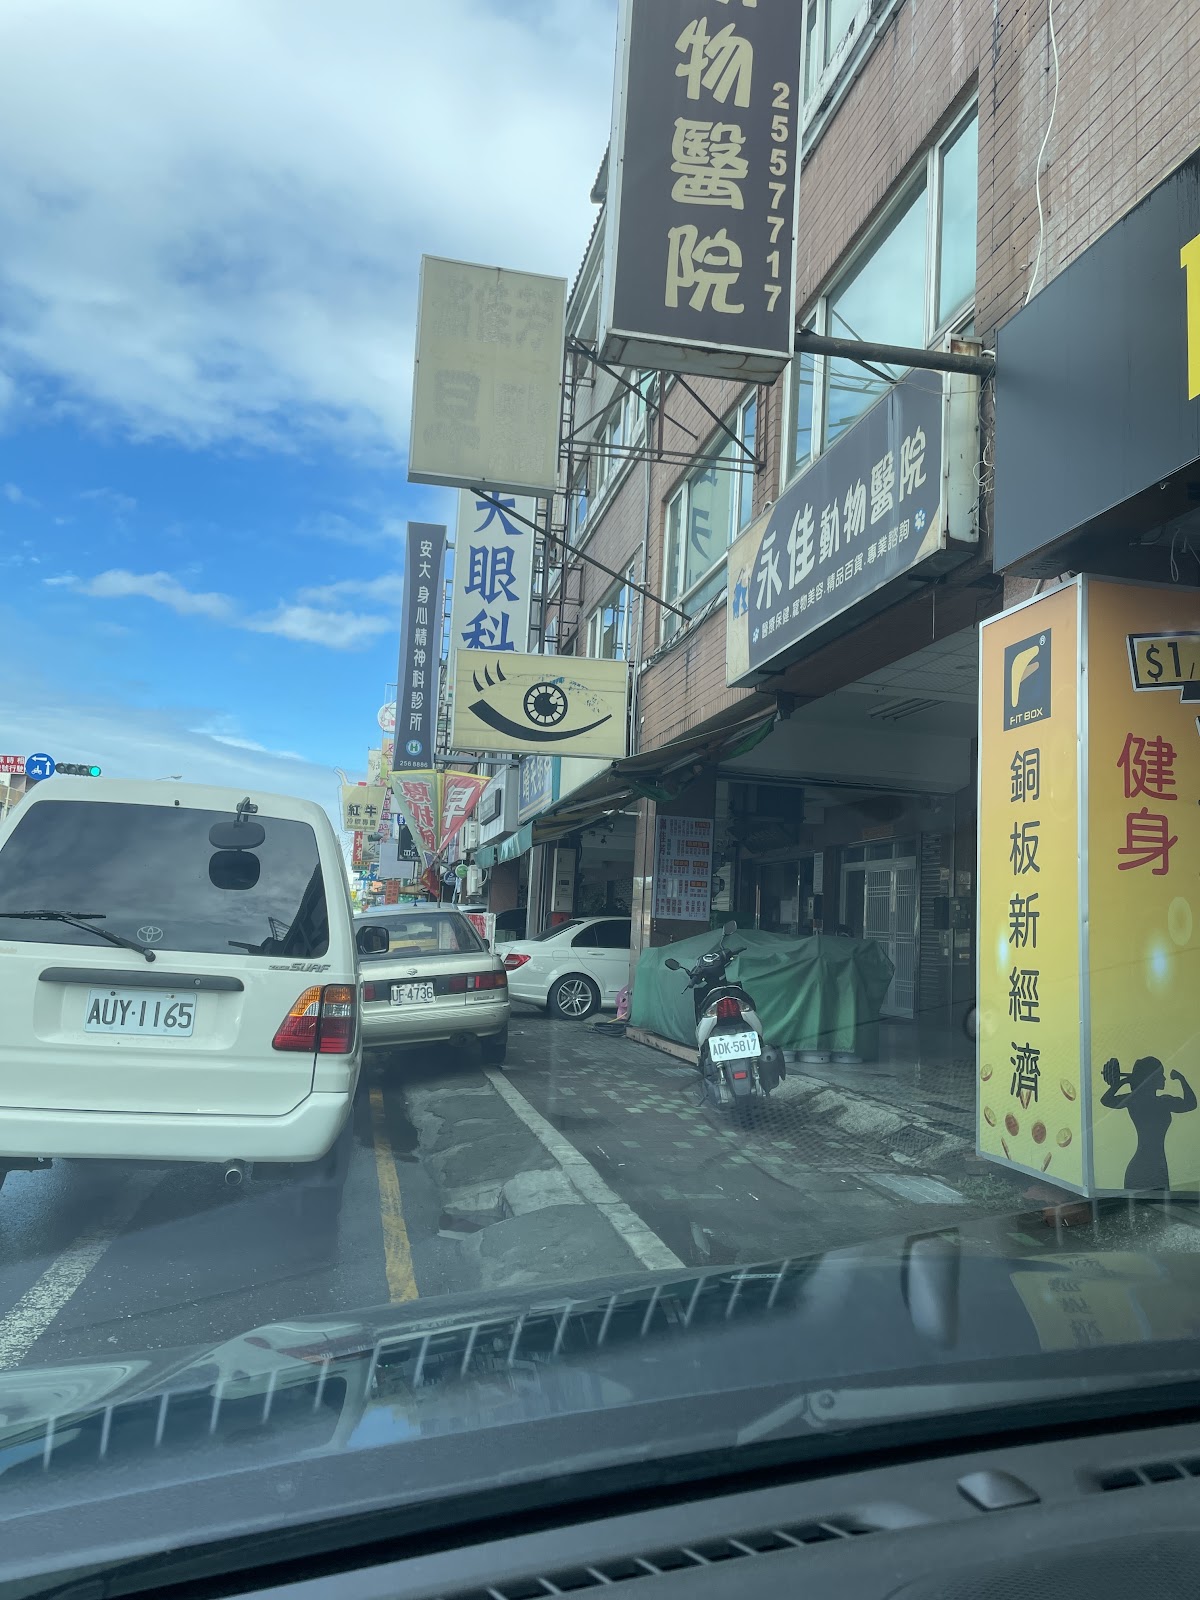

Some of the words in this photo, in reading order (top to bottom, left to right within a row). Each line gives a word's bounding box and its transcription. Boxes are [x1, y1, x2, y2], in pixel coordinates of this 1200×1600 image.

[664, 0, 754, 314] 物醫院
[763, 82, 790, 313] 2557717
[756, 424, 928, 611] 永佳動物醫院
[409, 539, 432, 731] 安大身心精神科診所
[1009, 713, 1023, 725] FIT
[1024, 707, 1043, 720] BOX
[347, 804, 378, 817] 紅牛
[1116, 732, 1179, 875] 健身
[1008, 747, 1042, 1103] 銅板新經濟
[87, 998, 194, 1029] AUY-1165
[713, 1039, 757, 1056] ADK-5817
